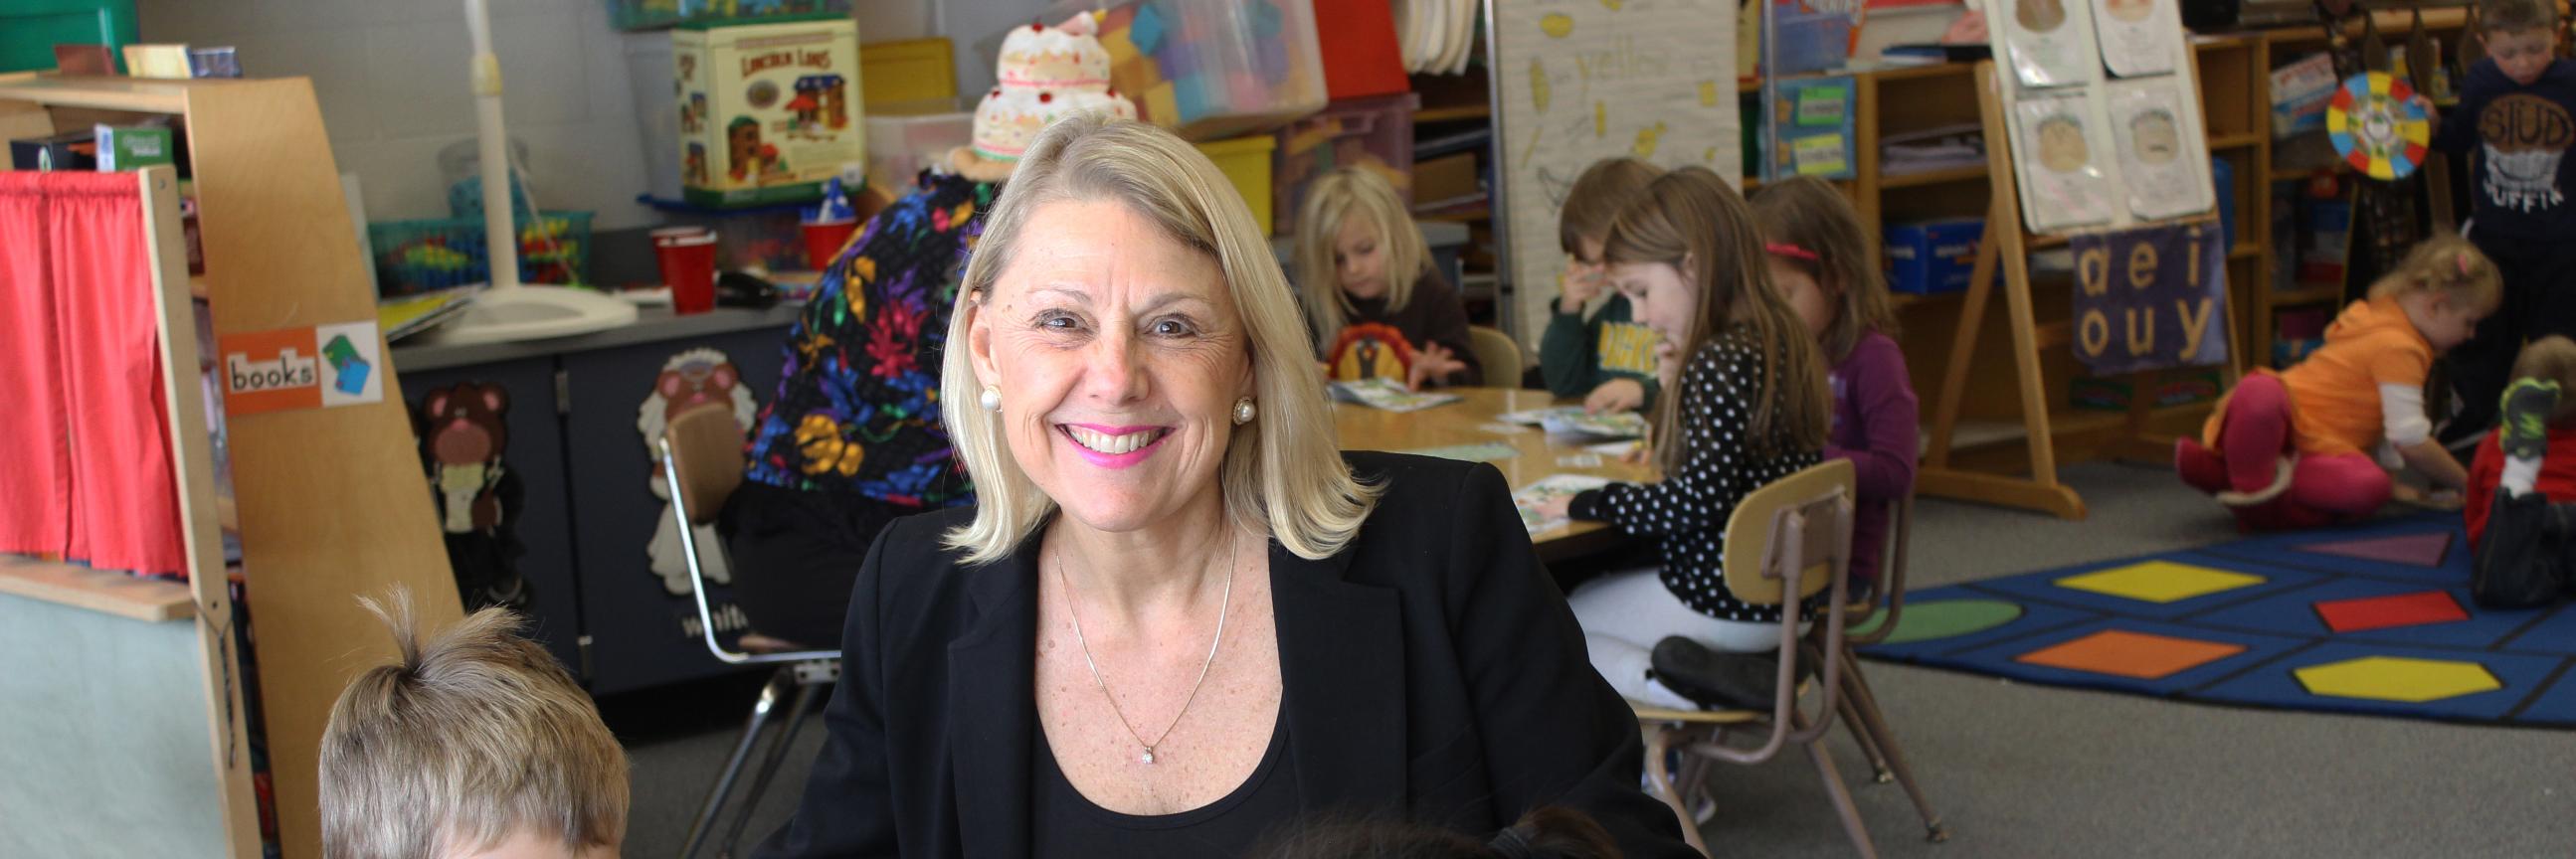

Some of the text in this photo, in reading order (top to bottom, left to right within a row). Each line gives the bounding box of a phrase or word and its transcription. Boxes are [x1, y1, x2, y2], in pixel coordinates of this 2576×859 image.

[2127, 242, 2158, 289] e
[2187, 227, 2202, 287] i
[2080, 295, 2214, 362] o u y
[230, 354, 313, 391] books
